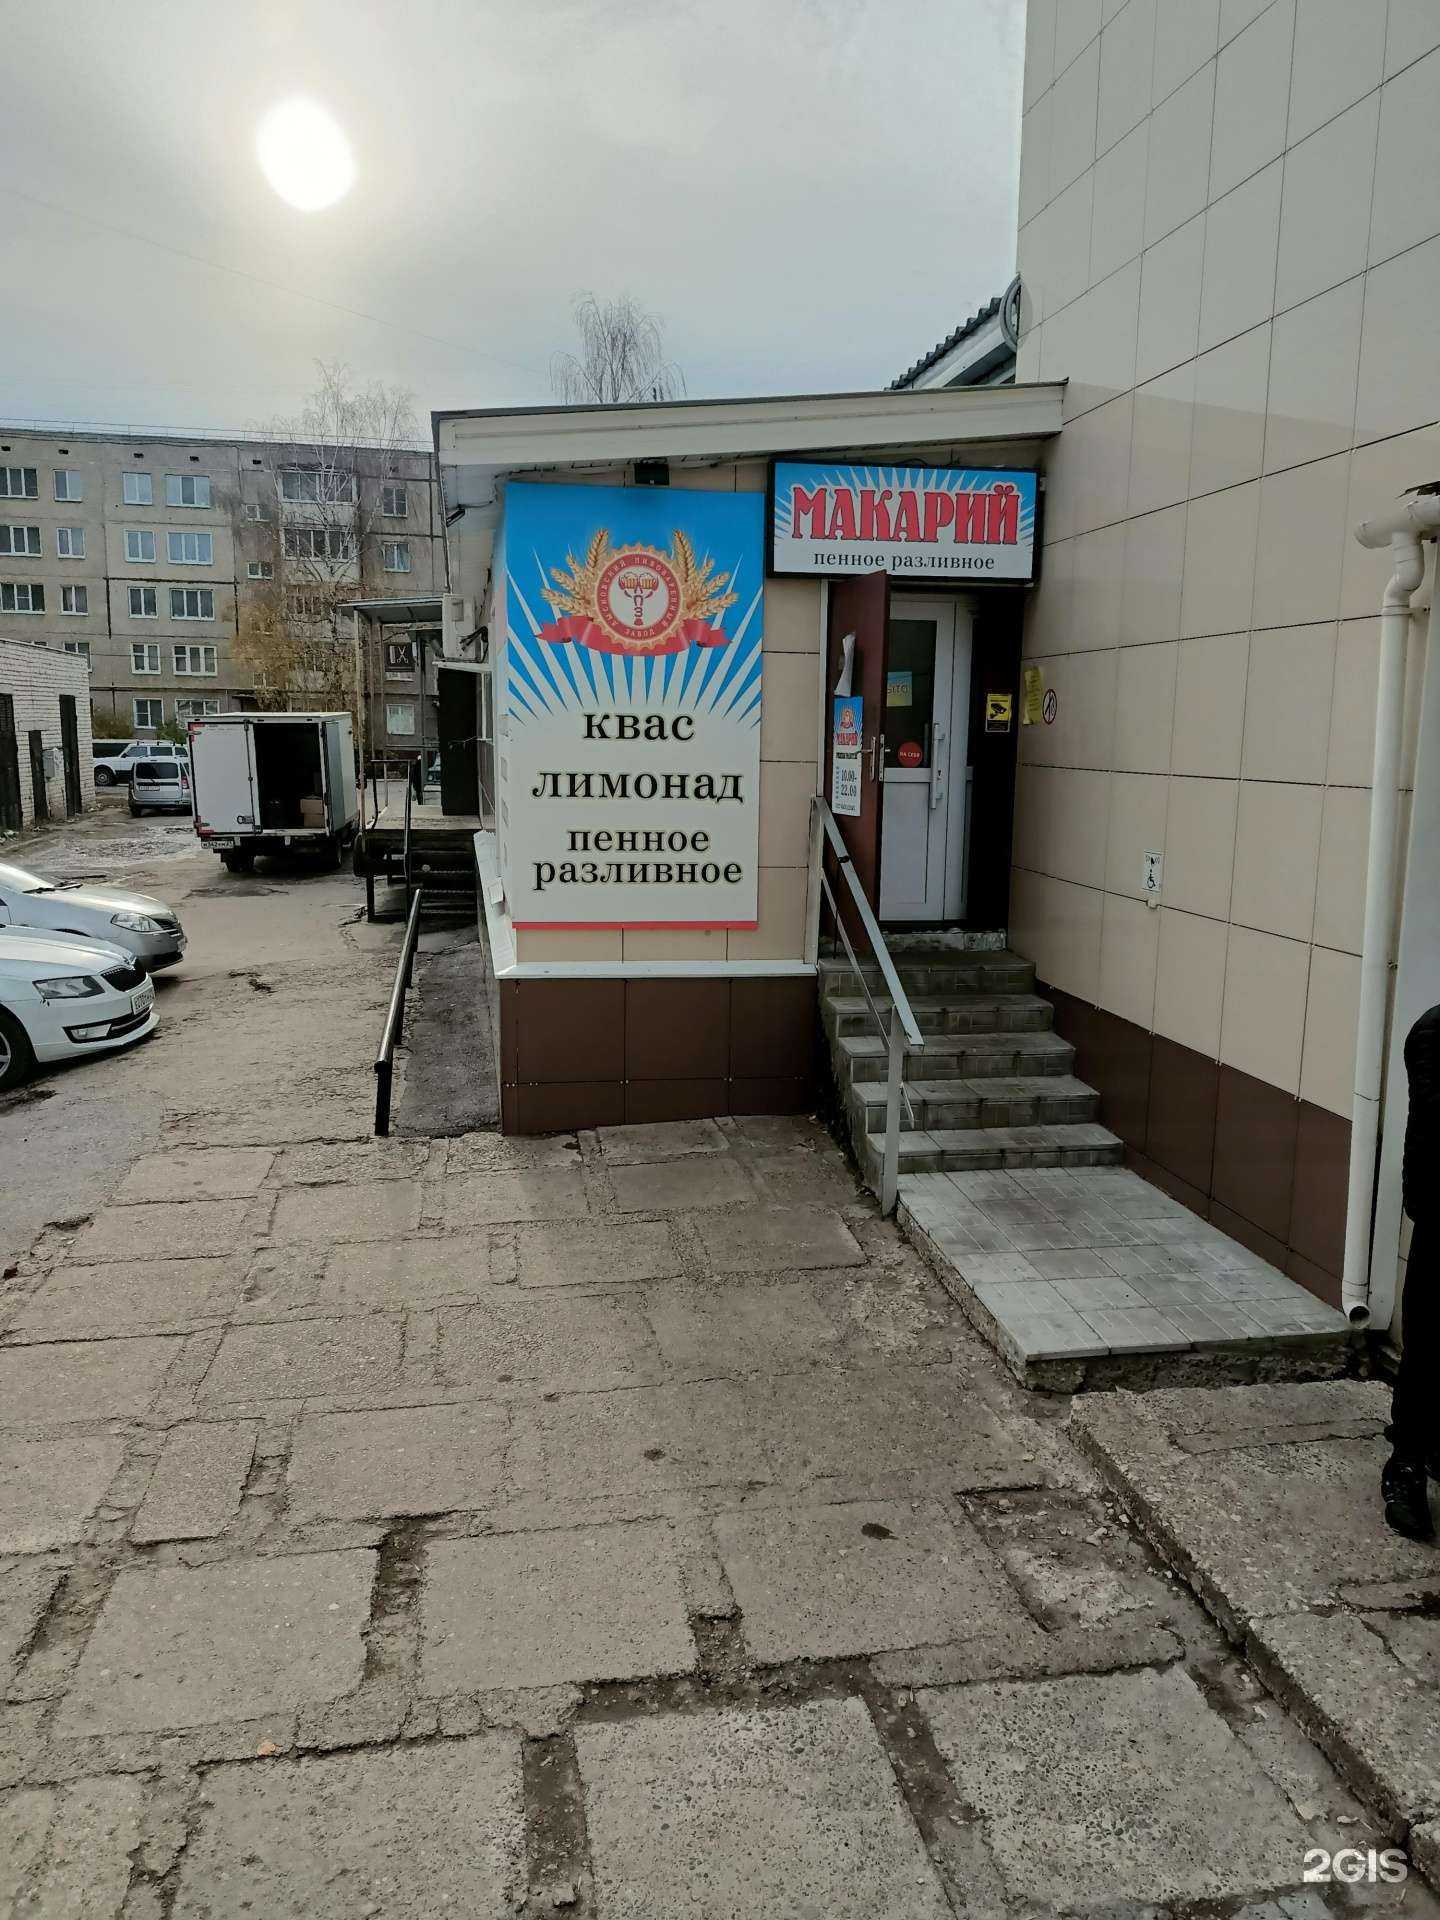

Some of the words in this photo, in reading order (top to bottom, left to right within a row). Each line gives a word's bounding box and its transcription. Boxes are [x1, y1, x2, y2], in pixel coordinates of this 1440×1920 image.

[791, 485, 1020, 545] МАКАРИЙ
[814, 552, 886, 568] пенное
[892, 554, 995, 571] разливное
[583, 713, 695, 741] квас
[532, 772, 744, 803] лимонад
[567, 830, 709, 852] пенное
[533, 860, 743, 891] разливное
